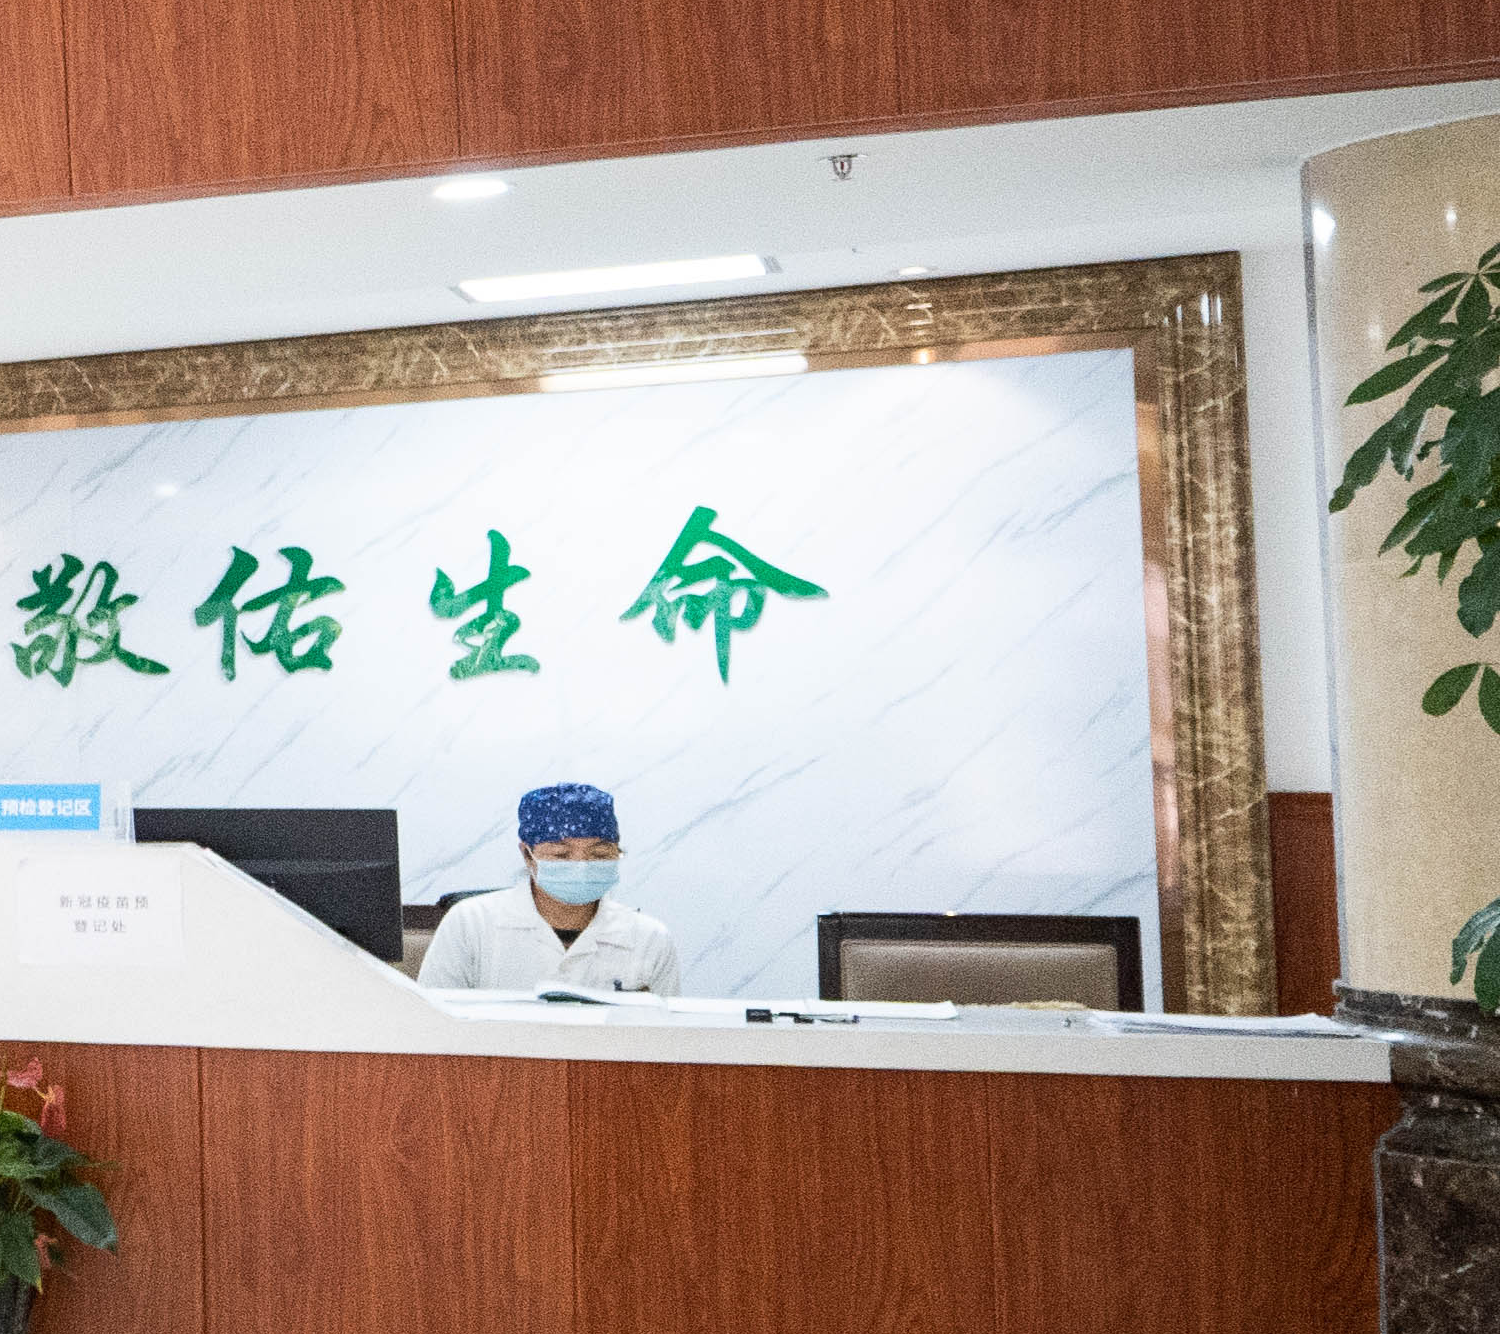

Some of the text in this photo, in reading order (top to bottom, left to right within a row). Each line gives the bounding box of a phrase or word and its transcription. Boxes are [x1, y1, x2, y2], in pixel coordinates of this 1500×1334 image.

[12, 505, 830, 688] 敬佑生命
[1, 798, 92, 816] 预检登记区
[60, 896, 148, 909] 新冠疫苗预
[74, 920, 126, 933] 登记处
